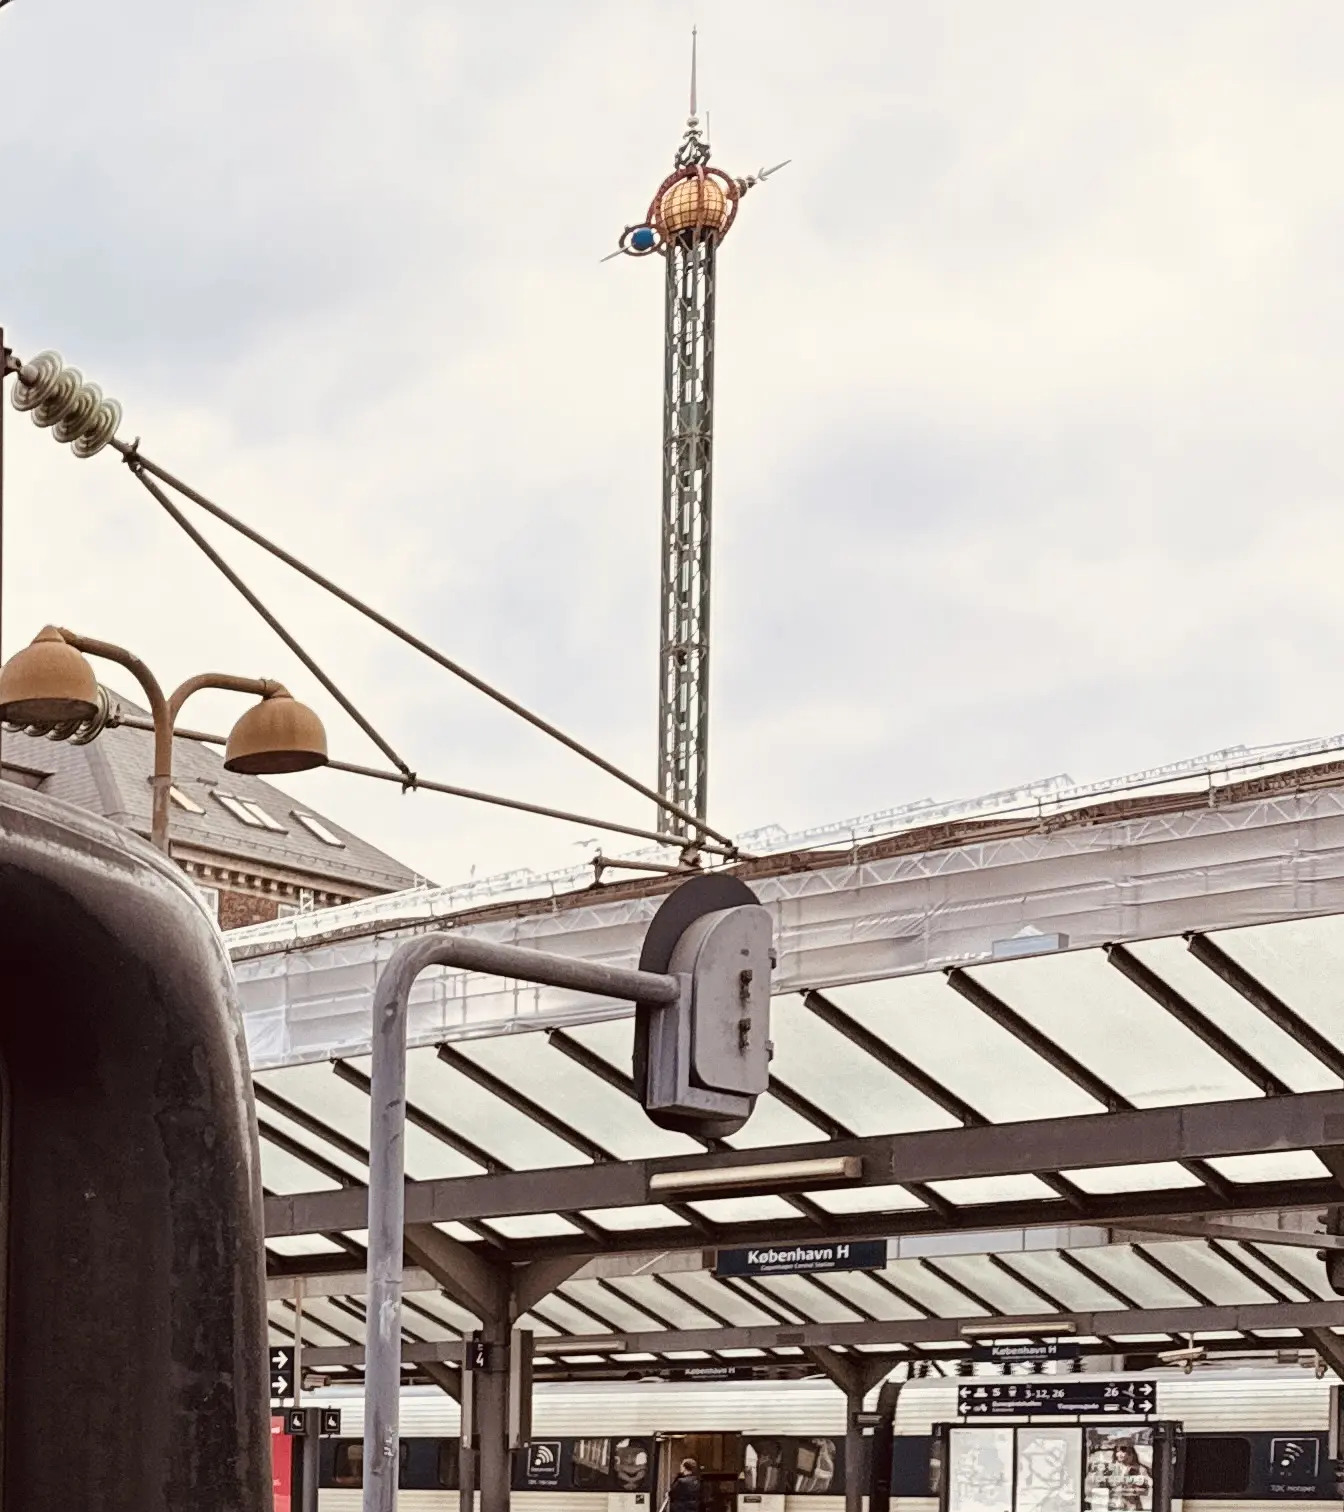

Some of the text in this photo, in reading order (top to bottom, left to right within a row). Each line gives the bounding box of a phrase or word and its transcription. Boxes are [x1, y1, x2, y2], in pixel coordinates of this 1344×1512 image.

[747, 1244, 850, 1265] København H
[991, 1345, 1057, 1356] København H
[476, 1351, 484, 1367] 4
[1103, 1387, 1119, 1397] 26
